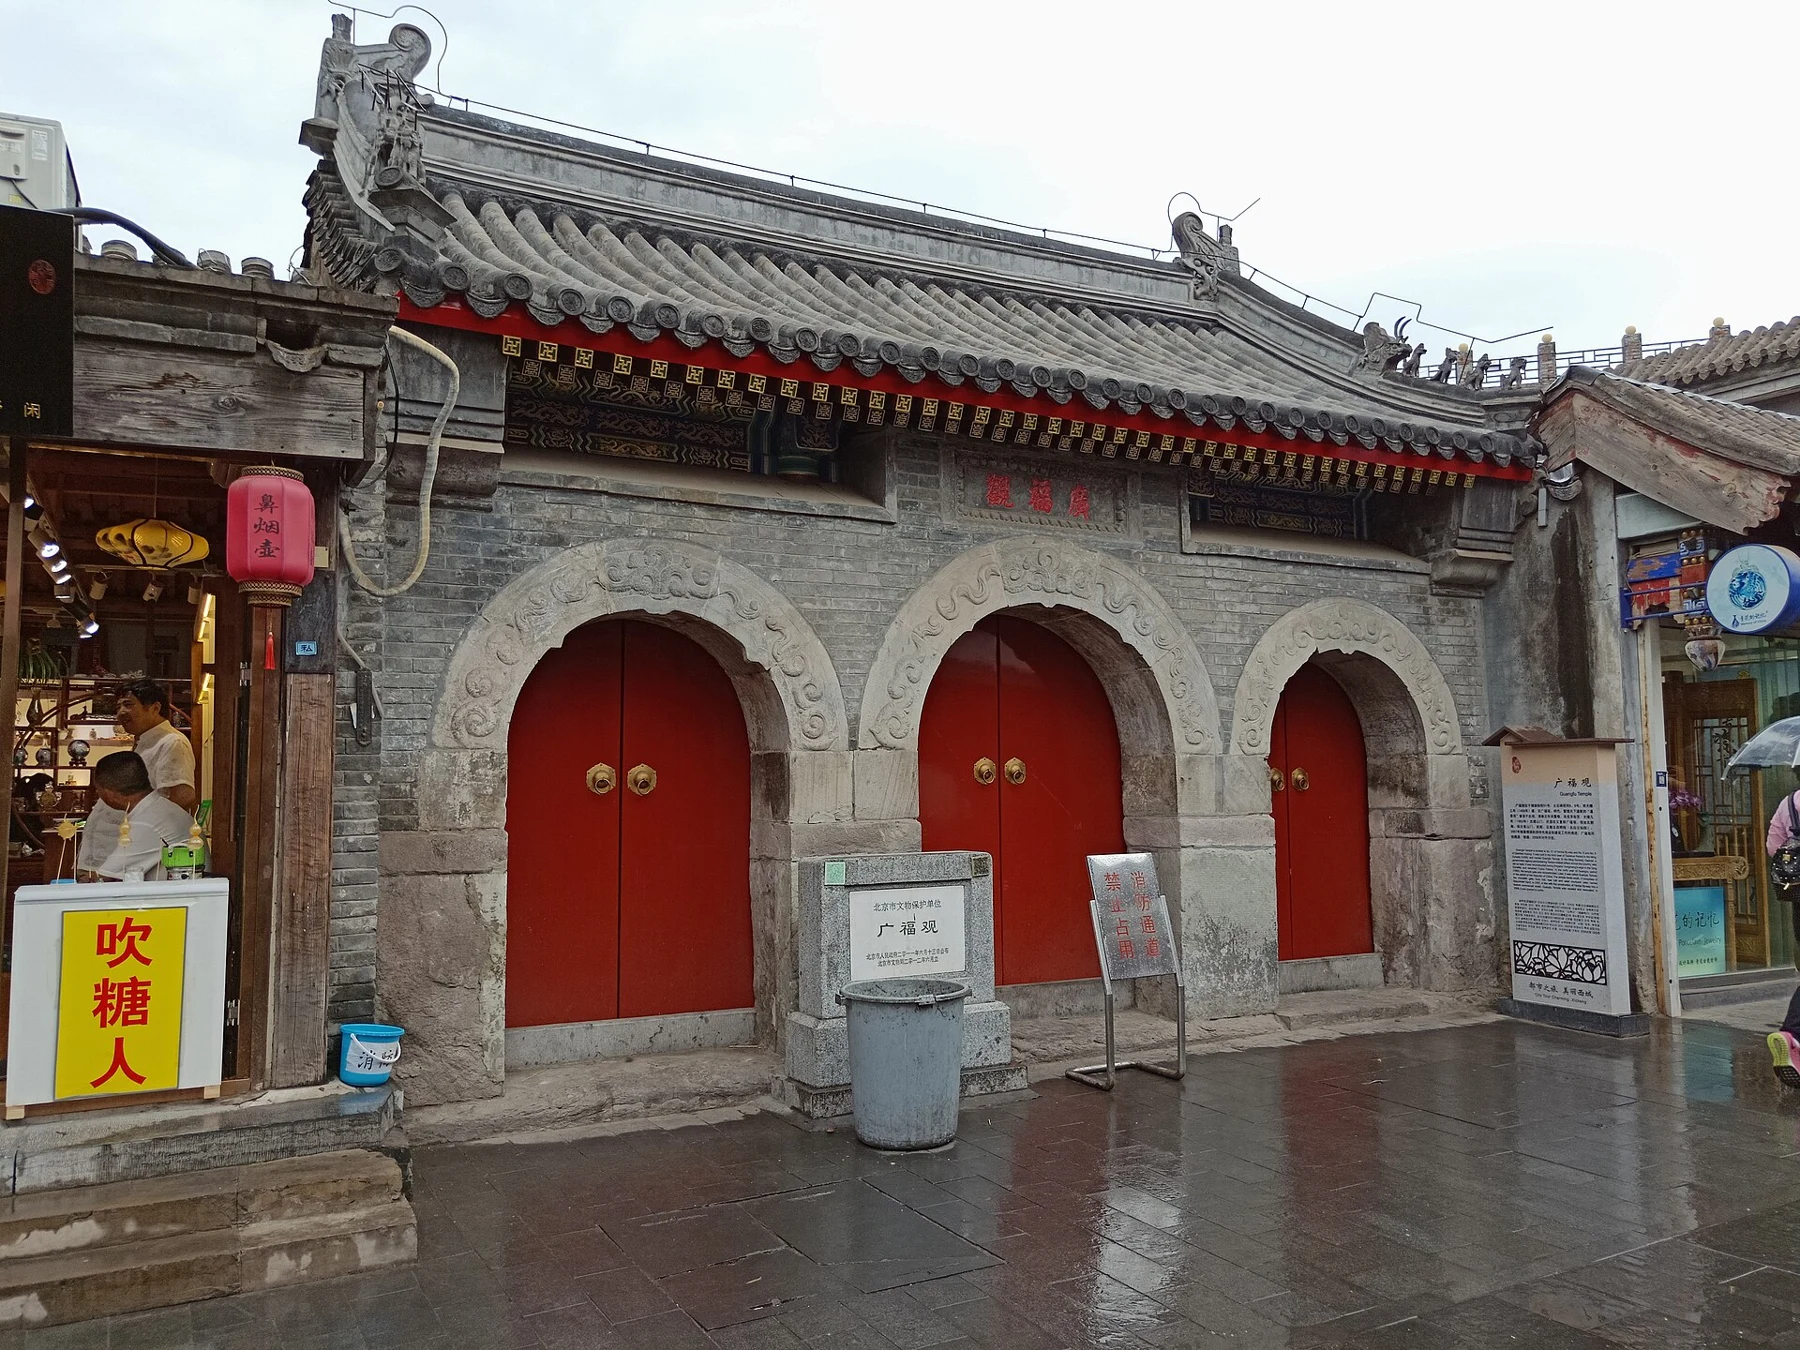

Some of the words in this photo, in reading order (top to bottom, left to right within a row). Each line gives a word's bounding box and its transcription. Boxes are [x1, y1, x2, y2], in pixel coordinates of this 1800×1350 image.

[873, 900, 942, 912] 北京市文物保护单位
[877, 920, 939, 938] 广福观
[1104, 872, 1135, 960] 禁止占用
[1130, 870, 1160, 959] 消防通道
[89, 916, 153, 1089] 吹糖人
